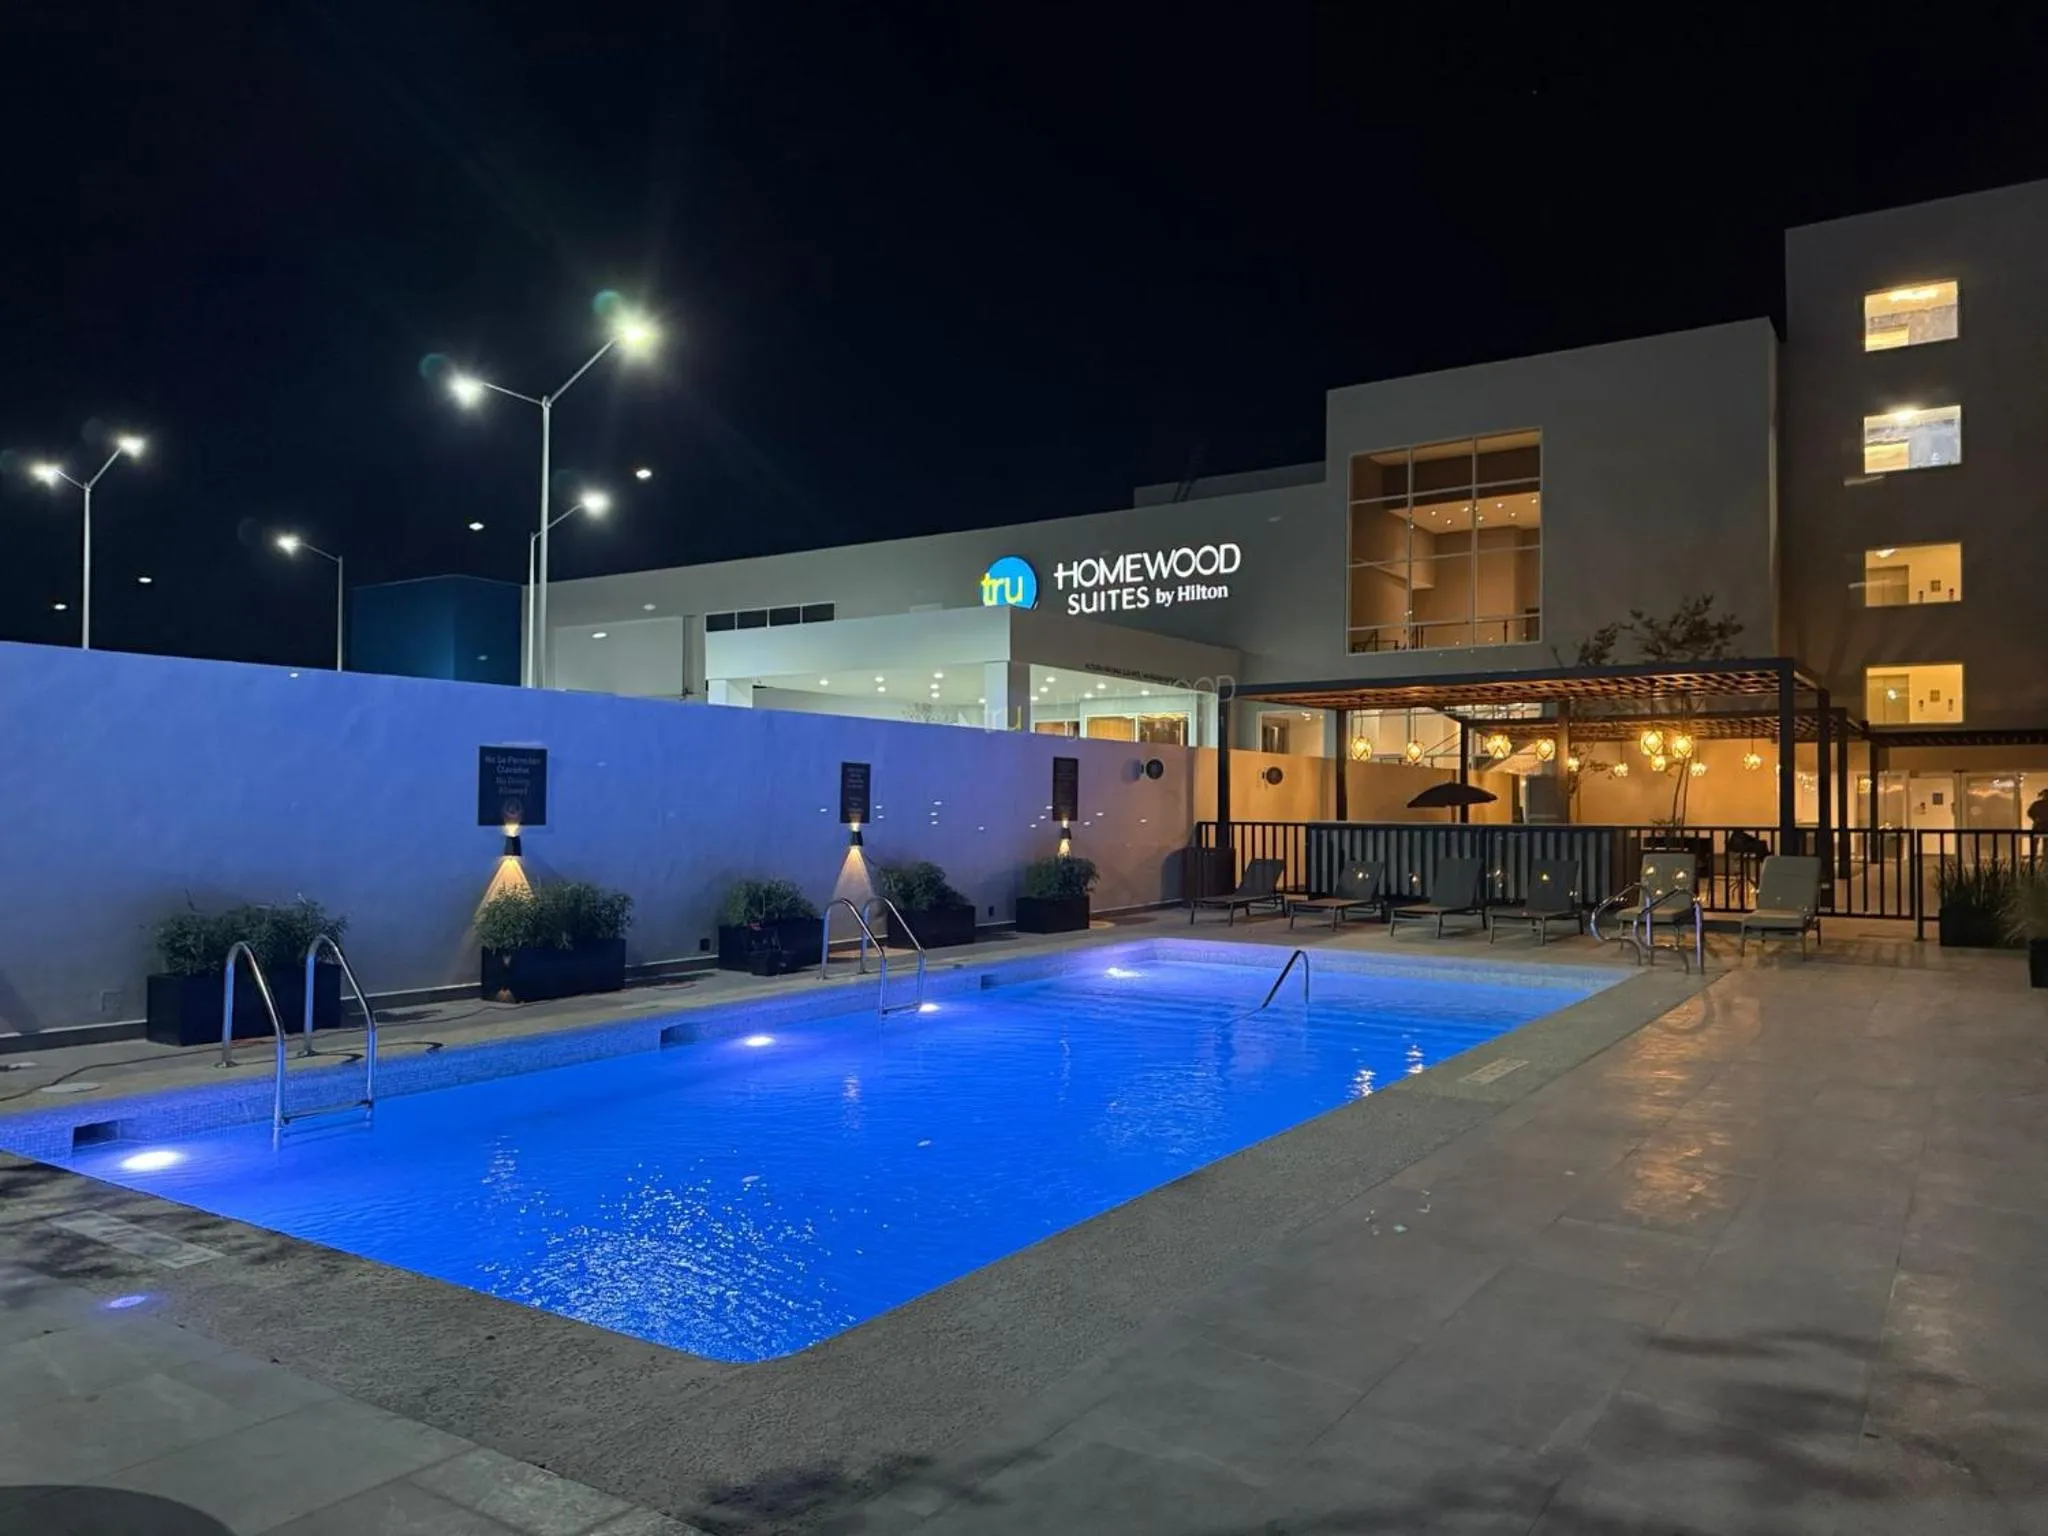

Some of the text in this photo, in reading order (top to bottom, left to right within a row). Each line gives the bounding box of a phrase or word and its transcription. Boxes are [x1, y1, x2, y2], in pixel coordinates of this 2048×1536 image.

[1053, 543, 1242, 591] HOMEWOOD
[980, 572, 1024, 607] tru
[1067, 583, 1229, 615] SUITES by Hilton
